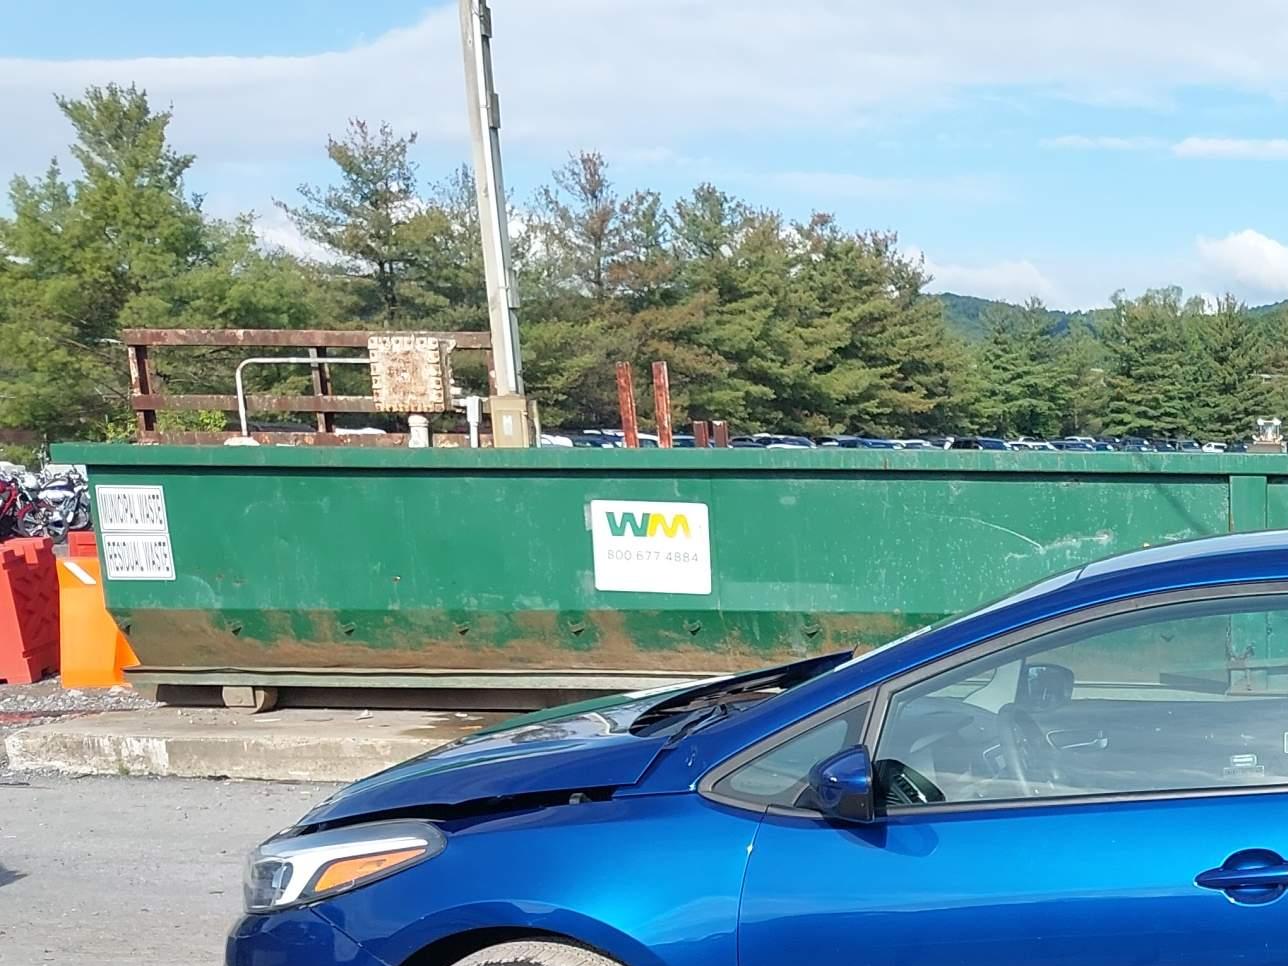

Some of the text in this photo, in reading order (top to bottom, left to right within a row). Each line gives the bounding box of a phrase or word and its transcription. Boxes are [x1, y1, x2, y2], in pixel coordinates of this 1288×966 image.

[137, 493, 163, 525] WASTE
[605, 511, 691, 538] WM
[107, 541, 170, 571] RESIDUAL WASTE
[607, 549, 632, 561] 800
[636, 550, 661, 561] 677
